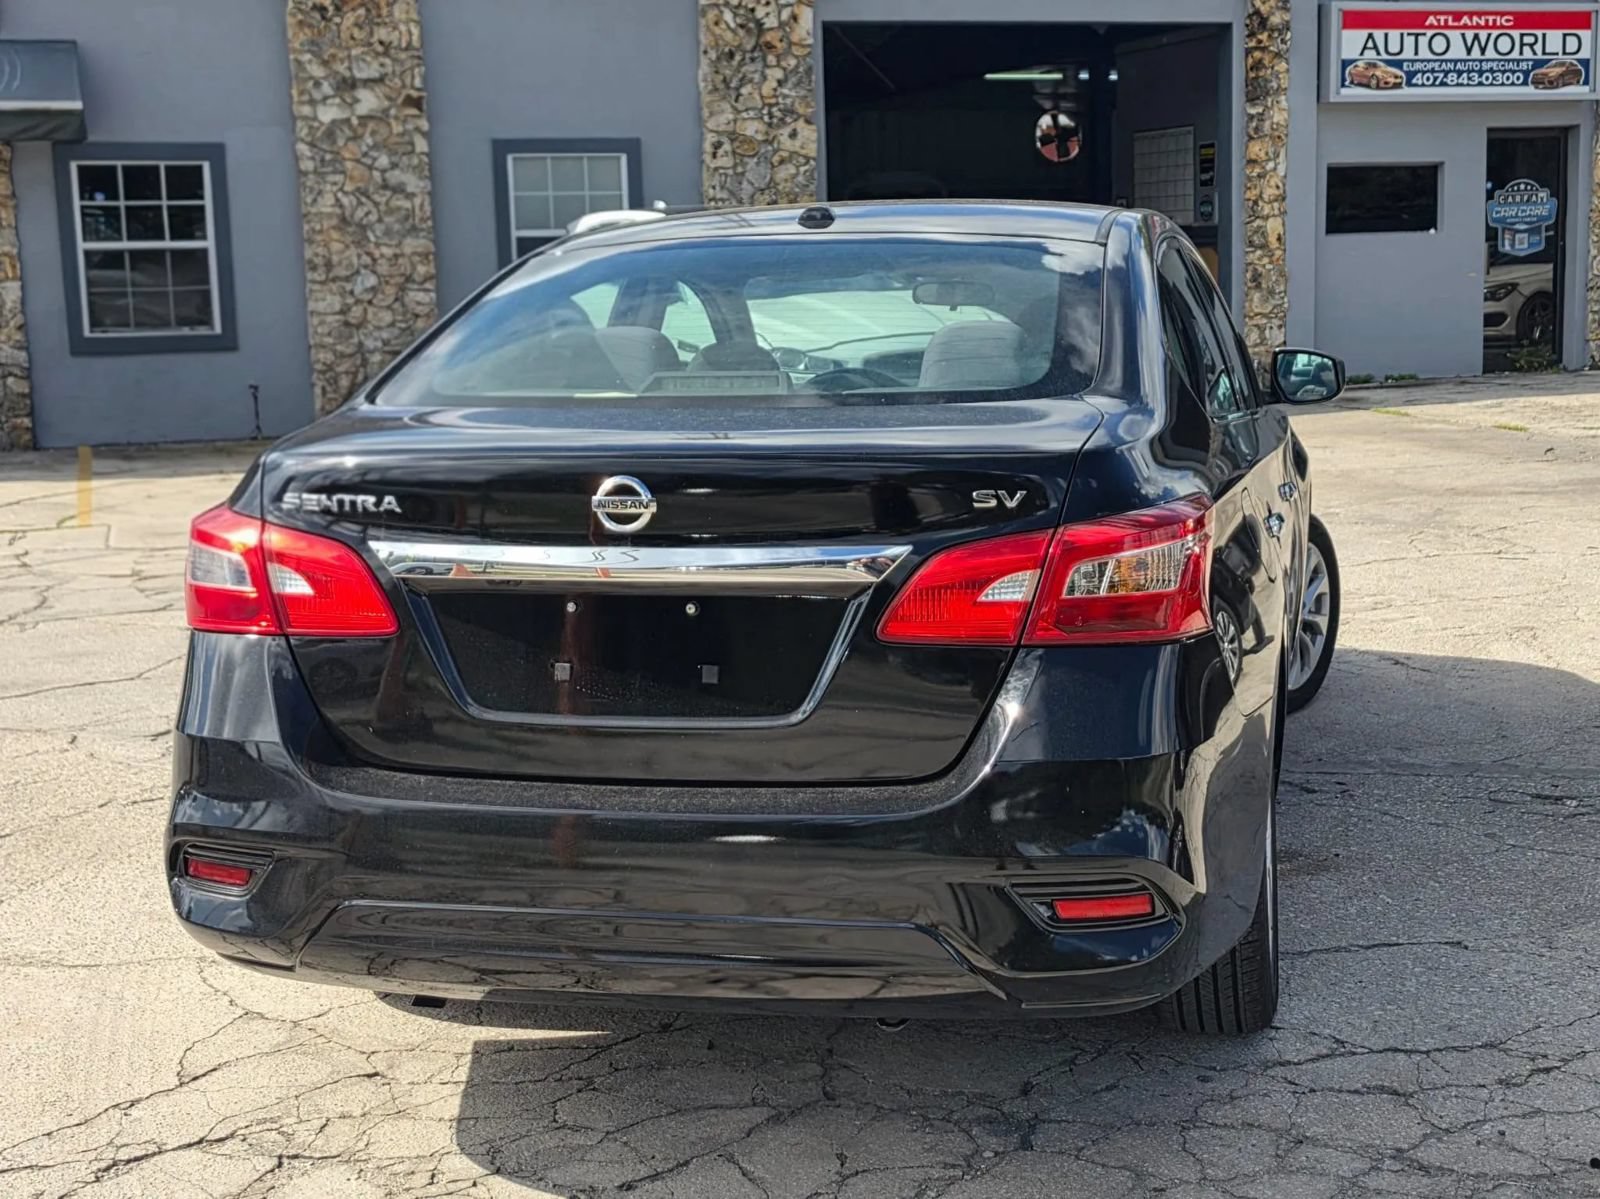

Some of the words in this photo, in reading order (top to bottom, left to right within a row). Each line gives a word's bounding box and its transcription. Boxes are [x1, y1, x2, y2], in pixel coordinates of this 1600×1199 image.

[1424, 15, 1514, 26] ATLANTIC
[1359, 32, 1451, 57] AUTO
[1461, 32, 1583, 57] WORLD
[1403, 61, 1454, 71] EUROPEAN
[1455, 61, 1480, 70] AUTO
[1481, 61, 1534, 70] SPECIALIST
[1411, 72, 1524, 86] 407-843-0300
[1493, 207, 1517, 217] CAR
[1518, 205, 1551, 216] CARE
[281, 493, 402, 513] SENTRA
[597, 500, 649, 510] NISSAN
[972, 489, 1028, 509] SV
